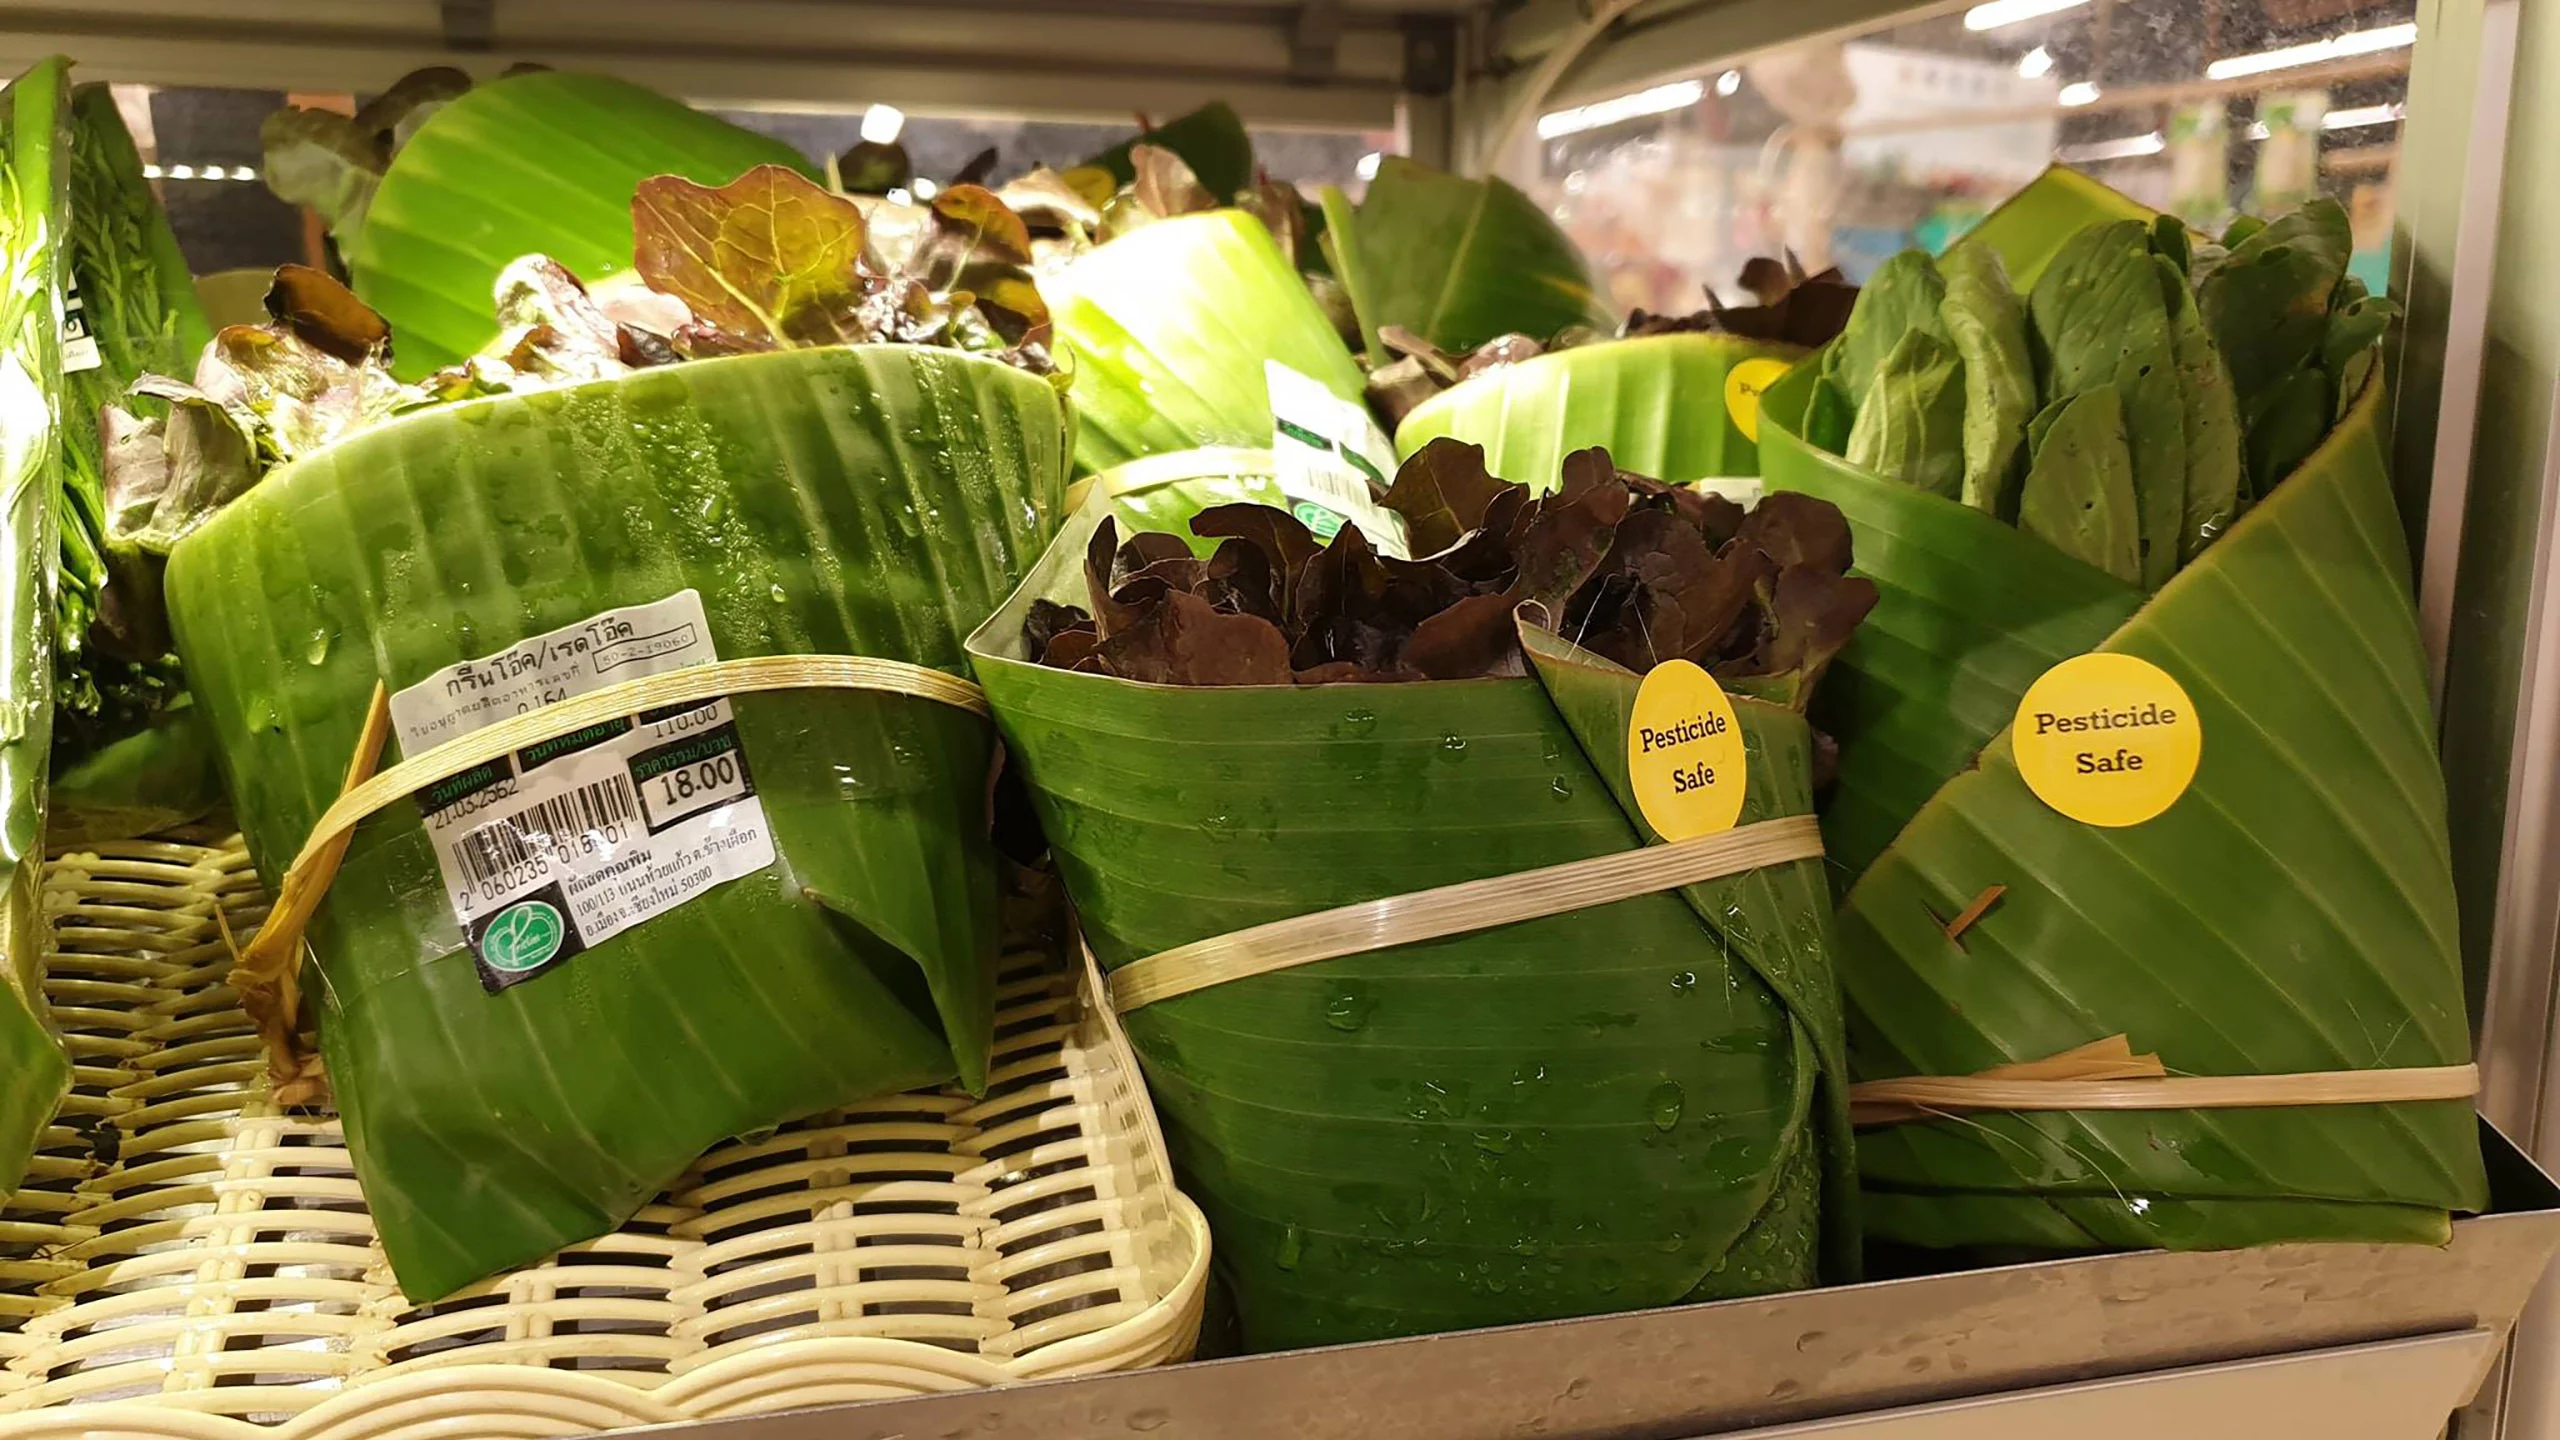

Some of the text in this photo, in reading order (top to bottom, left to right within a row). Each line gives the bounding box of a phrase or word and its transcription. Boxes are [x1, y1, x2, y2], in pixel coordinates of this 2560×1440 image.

[445, 615, 635, 698] กรีนโอ๊ค/เรดโอ๊ค
[516, 687, 569, 715] 0164
[2034, 702, 2178, 736] Pesticide
[1638, 709, 1727, 754] Pesticide
[660, 756, 735, 806] 18.00
[1672, 760, 1716, 796] Safe
[2075, 748, 2144, 775] Safe
[481, 854, 549, 901] 060235
[557, 823, 630, 865] 01801
[575, 887, 617, 917] 100/113
[621, 878, 679, 921] จ.ชียงใหม่
[680, 864, 714, 895] 50300
